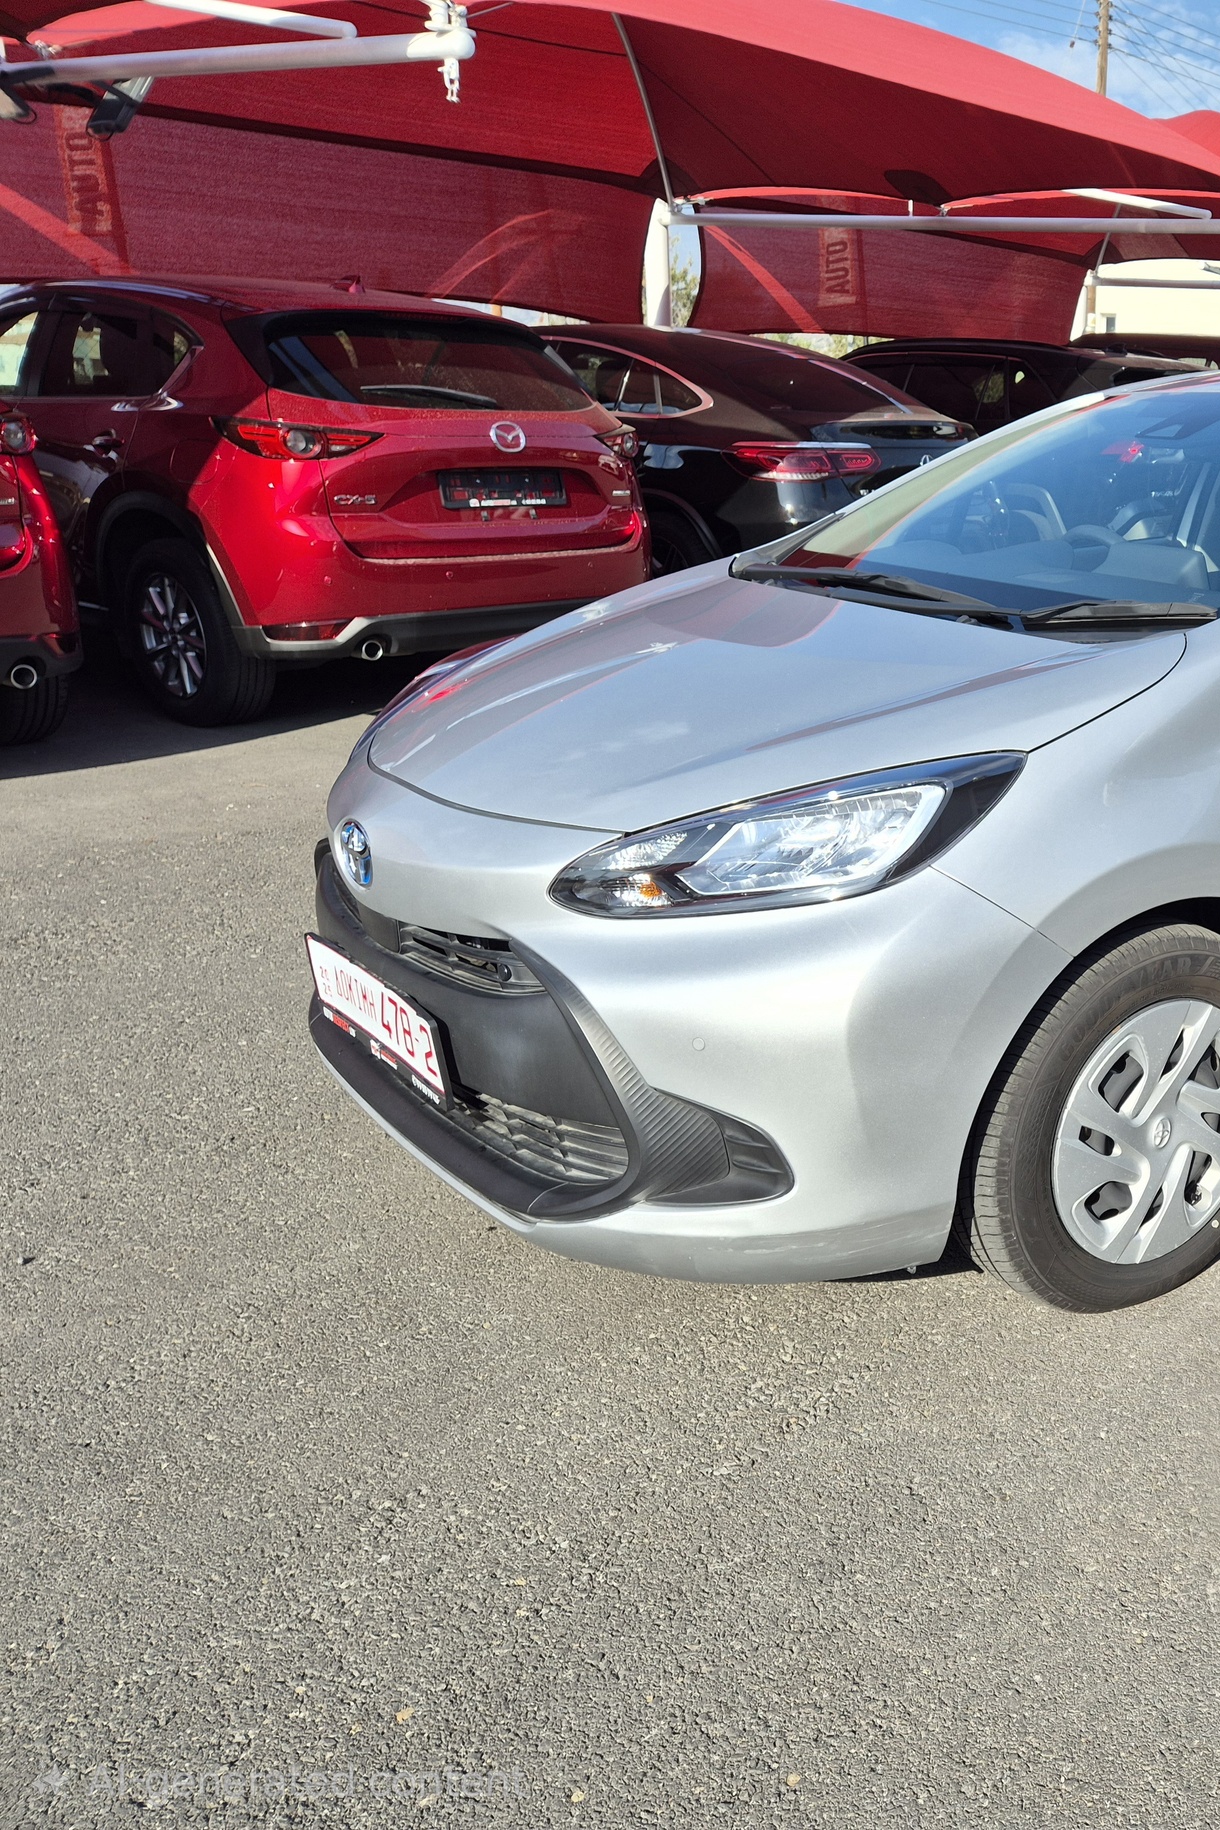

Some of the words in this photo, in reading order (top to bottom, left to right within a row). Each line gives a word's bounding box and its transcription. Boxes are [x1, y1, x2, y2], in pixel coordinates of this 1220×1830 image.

[825, 240, 850, 294] AUTO
[334, 494, 376, 505] CX-5
[381, 991, 438, 1078] 478-2
